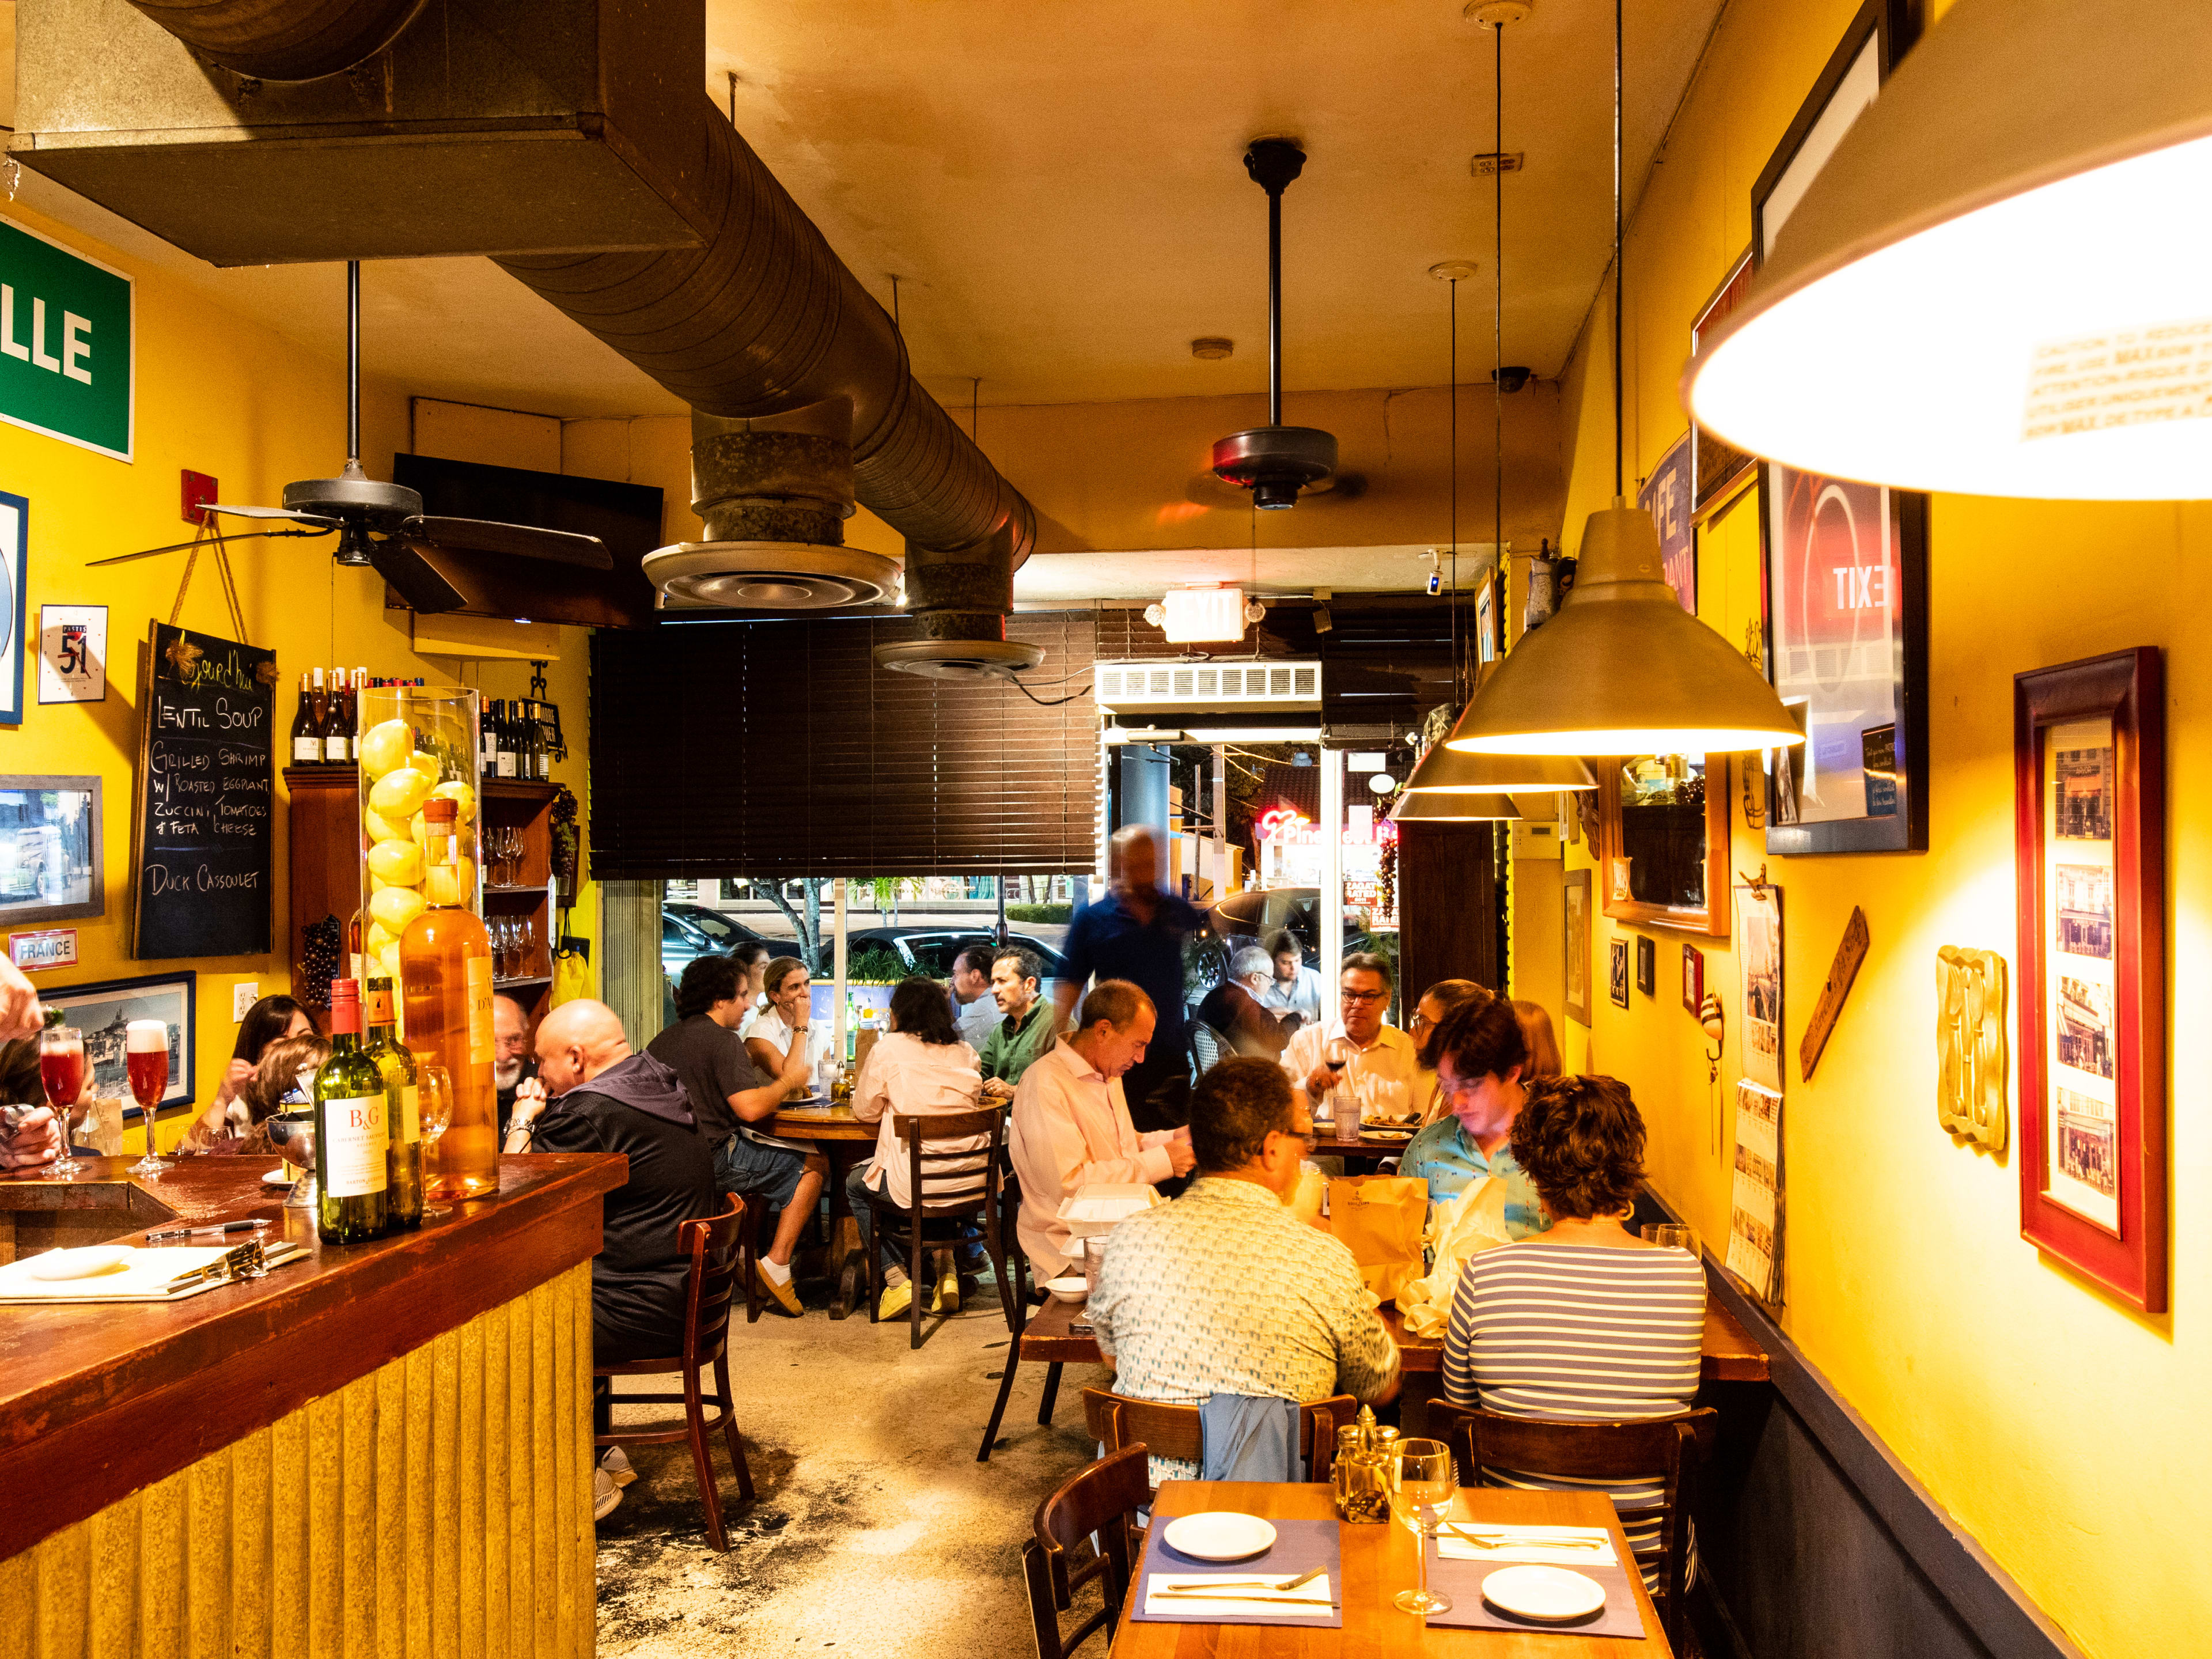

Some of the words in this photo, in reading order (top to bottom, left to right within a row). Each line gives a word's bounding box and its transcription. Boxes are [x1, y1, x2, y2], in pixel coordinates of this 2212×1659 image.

[59, 635, 87, 674] 51
[158, 696, 210, 729] LENTIL
[216, 698, 263, 729] SOUP
[151, 741, 210, 774] GRILLED
[218, 748, 266, 767] SHRIMP
[173, 773, 215, 794] ROASTED
[170, 821, 199, 834] FETA
[145, 864, 190, 896] DUCK
[197, 864, 259, 892] CASSOULET
[20, 941, 70, 960] FRANCE
